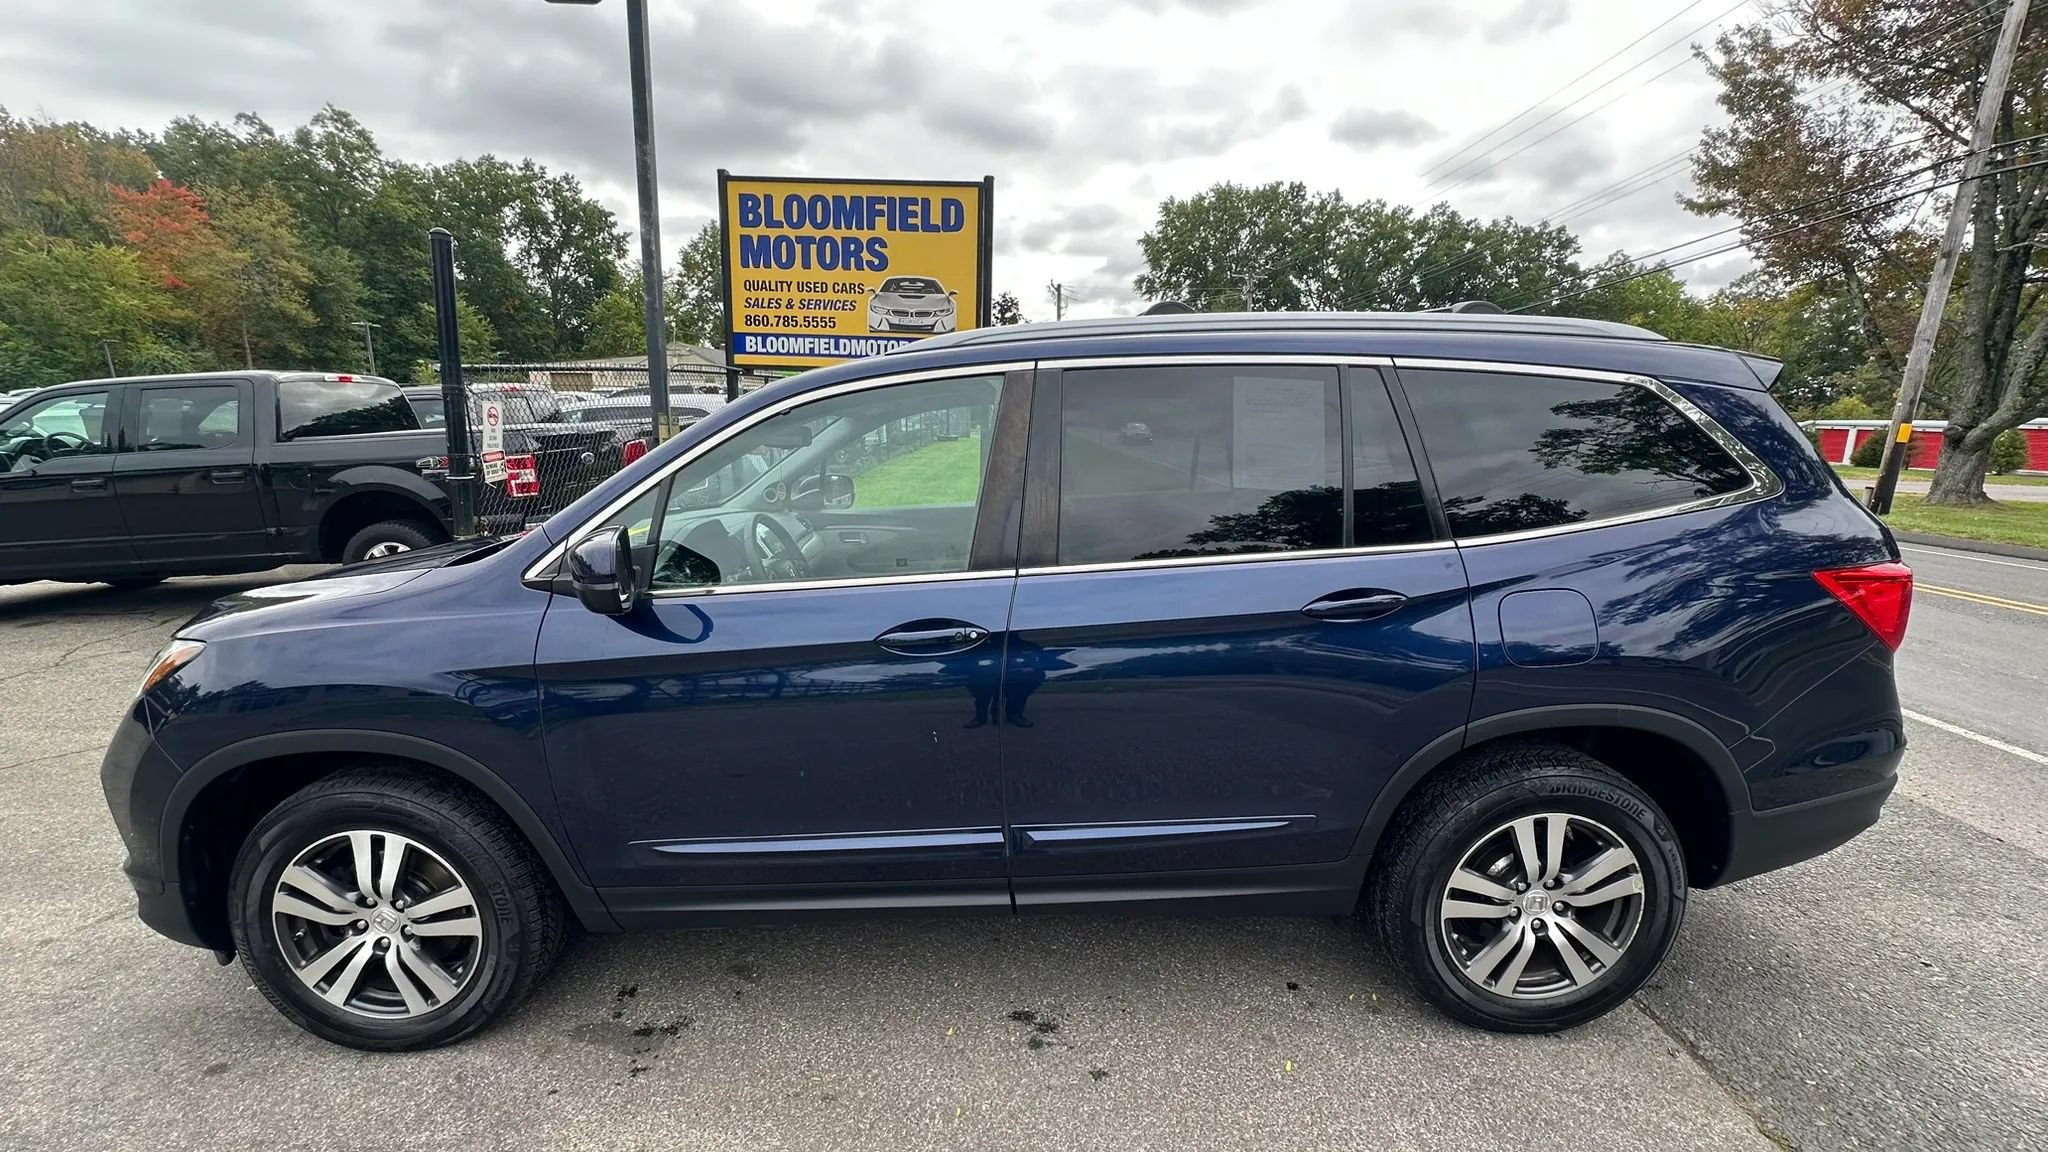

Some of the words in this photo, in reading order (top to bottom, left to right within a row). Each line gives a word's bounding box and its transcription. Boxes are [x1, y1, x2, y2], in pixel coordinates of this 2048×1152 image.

[738, 193, 965, 233] BLOOMFIELD
[738, 234, 889, 272] MOTORS
[744, 279, 793, 294] QUALITY
[796, 281, 828, 294] USED
[832, 282, 865, 295] CARS
[744, 297, 782, 310] SALES
[785, 298, 795, 310] &
[798, 299, 857, 312] SERVICES
[744, 314, 837, 329] 860.785.5555
[1549, 783, 1647, 820] BRIDGESTONE
